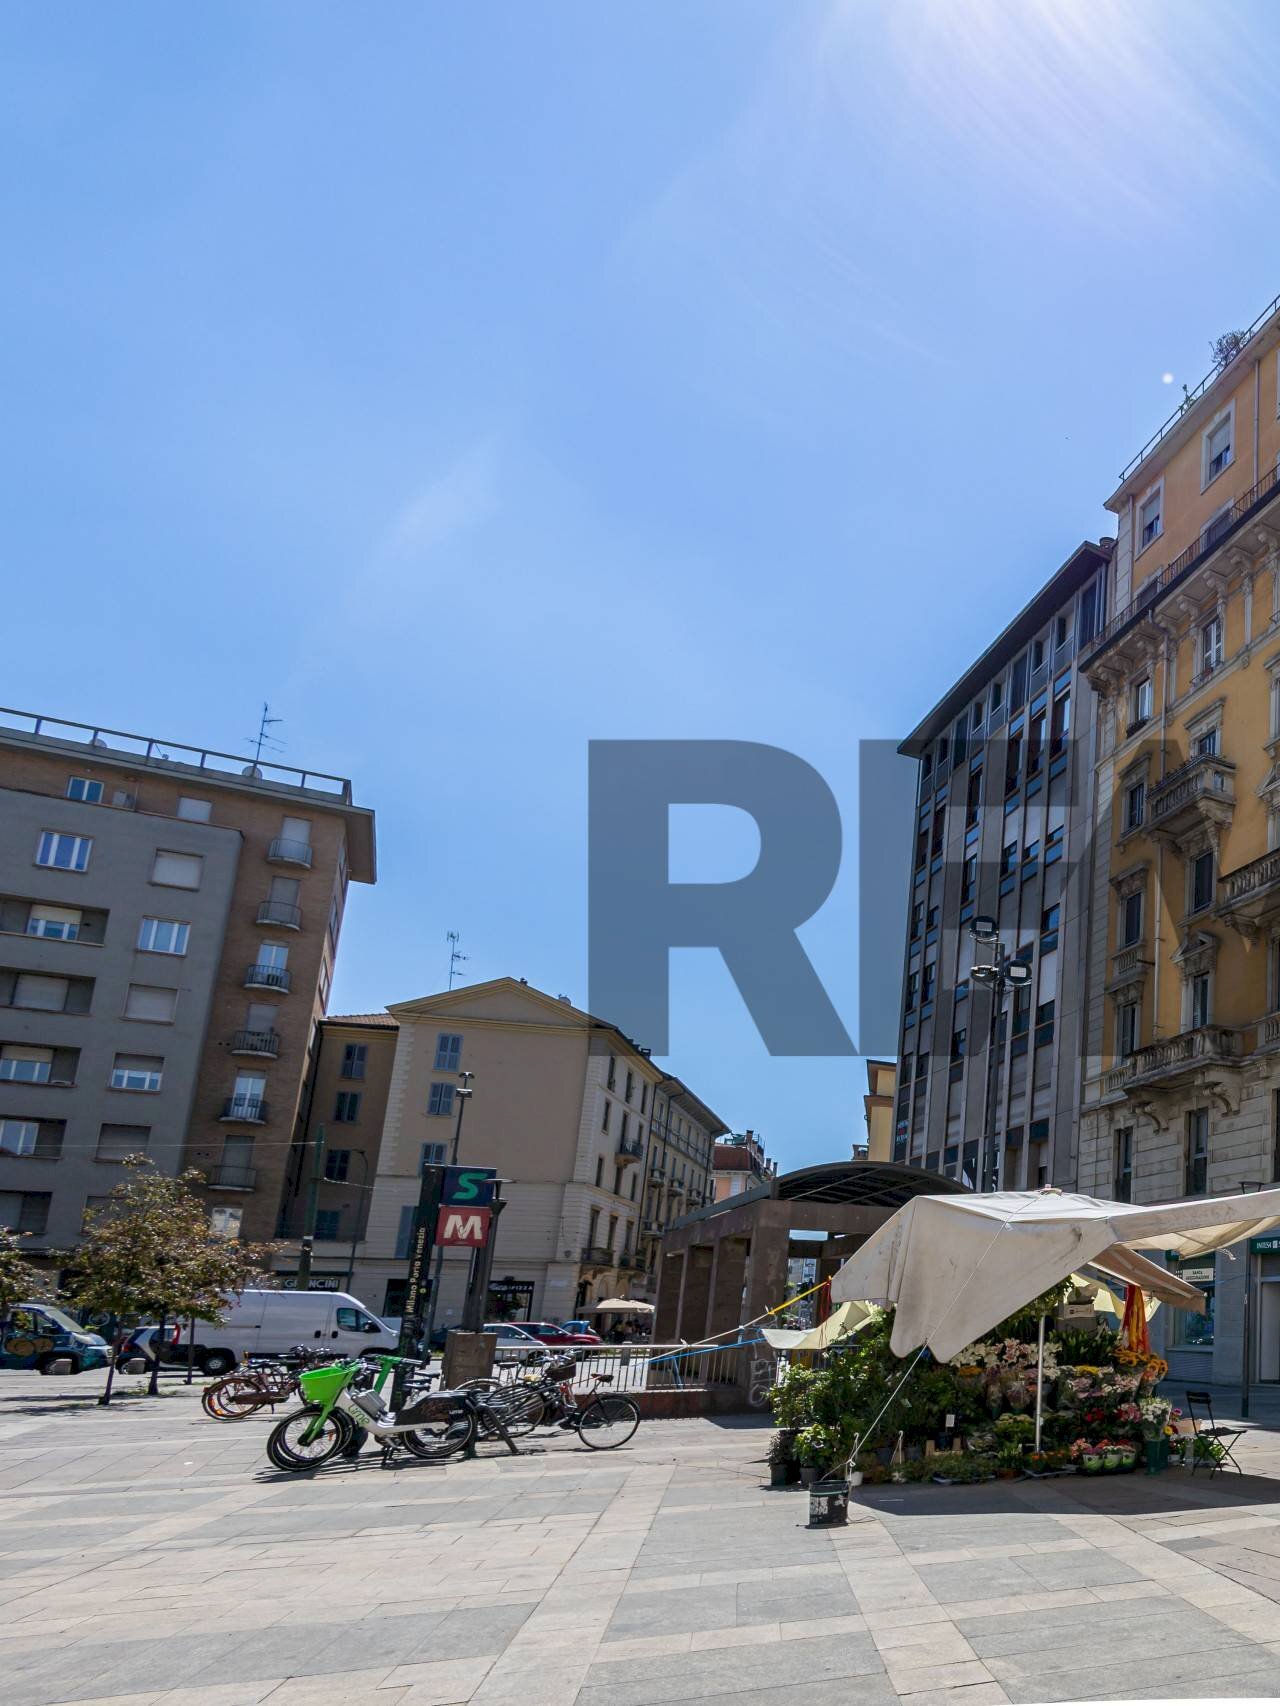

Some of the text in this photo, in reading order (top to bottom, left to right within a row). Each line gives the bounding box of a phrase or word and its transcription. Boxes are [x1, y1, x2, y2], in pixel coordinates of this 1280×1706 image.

[443, 1214, 483, 1240] M
[1256, 1240, 1273, 1249] INTESA
[284, 1279, 339, 1289] GINCINI
